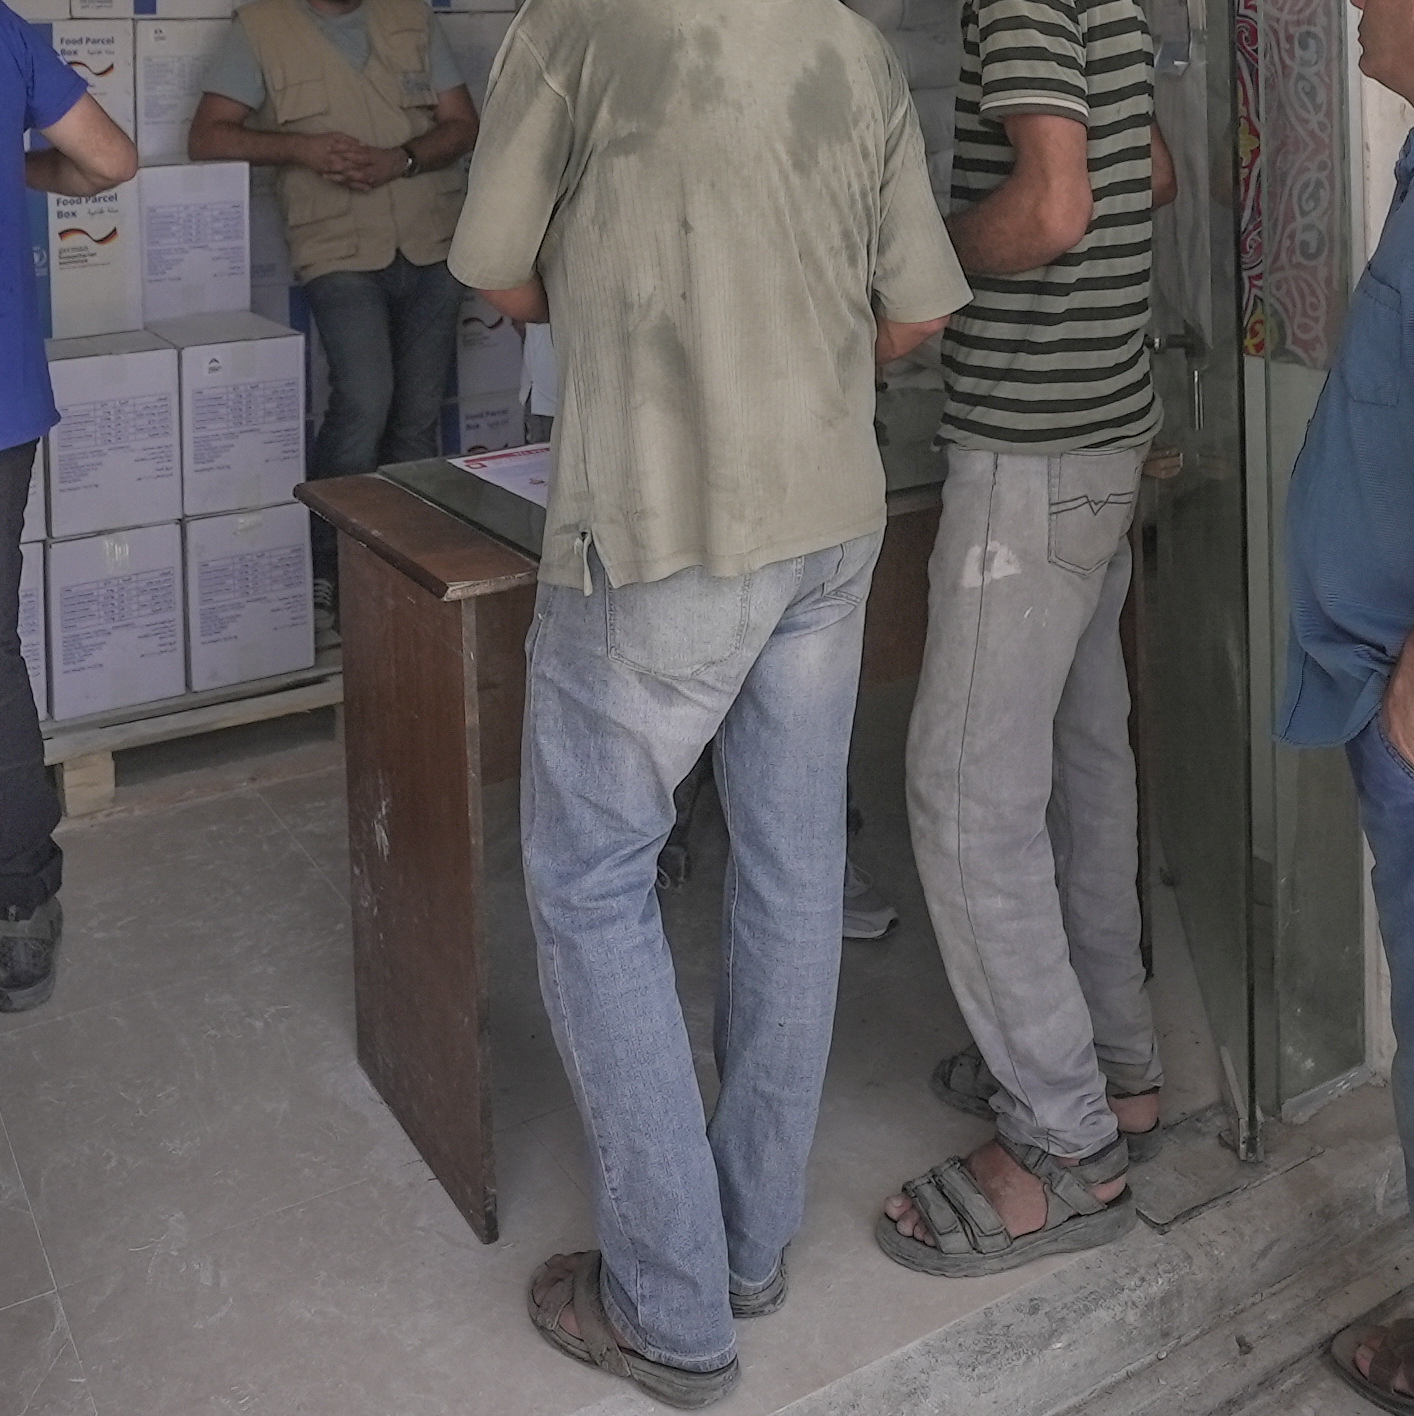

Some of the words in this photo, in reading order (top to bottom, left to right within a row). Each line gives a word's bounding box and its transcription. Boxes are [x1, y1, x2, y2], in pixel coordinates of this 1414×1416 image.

[86, 36, 114, 44] Parcel
[57, 197, 82, 206] Food
[57, 211, 76, 219] Box
